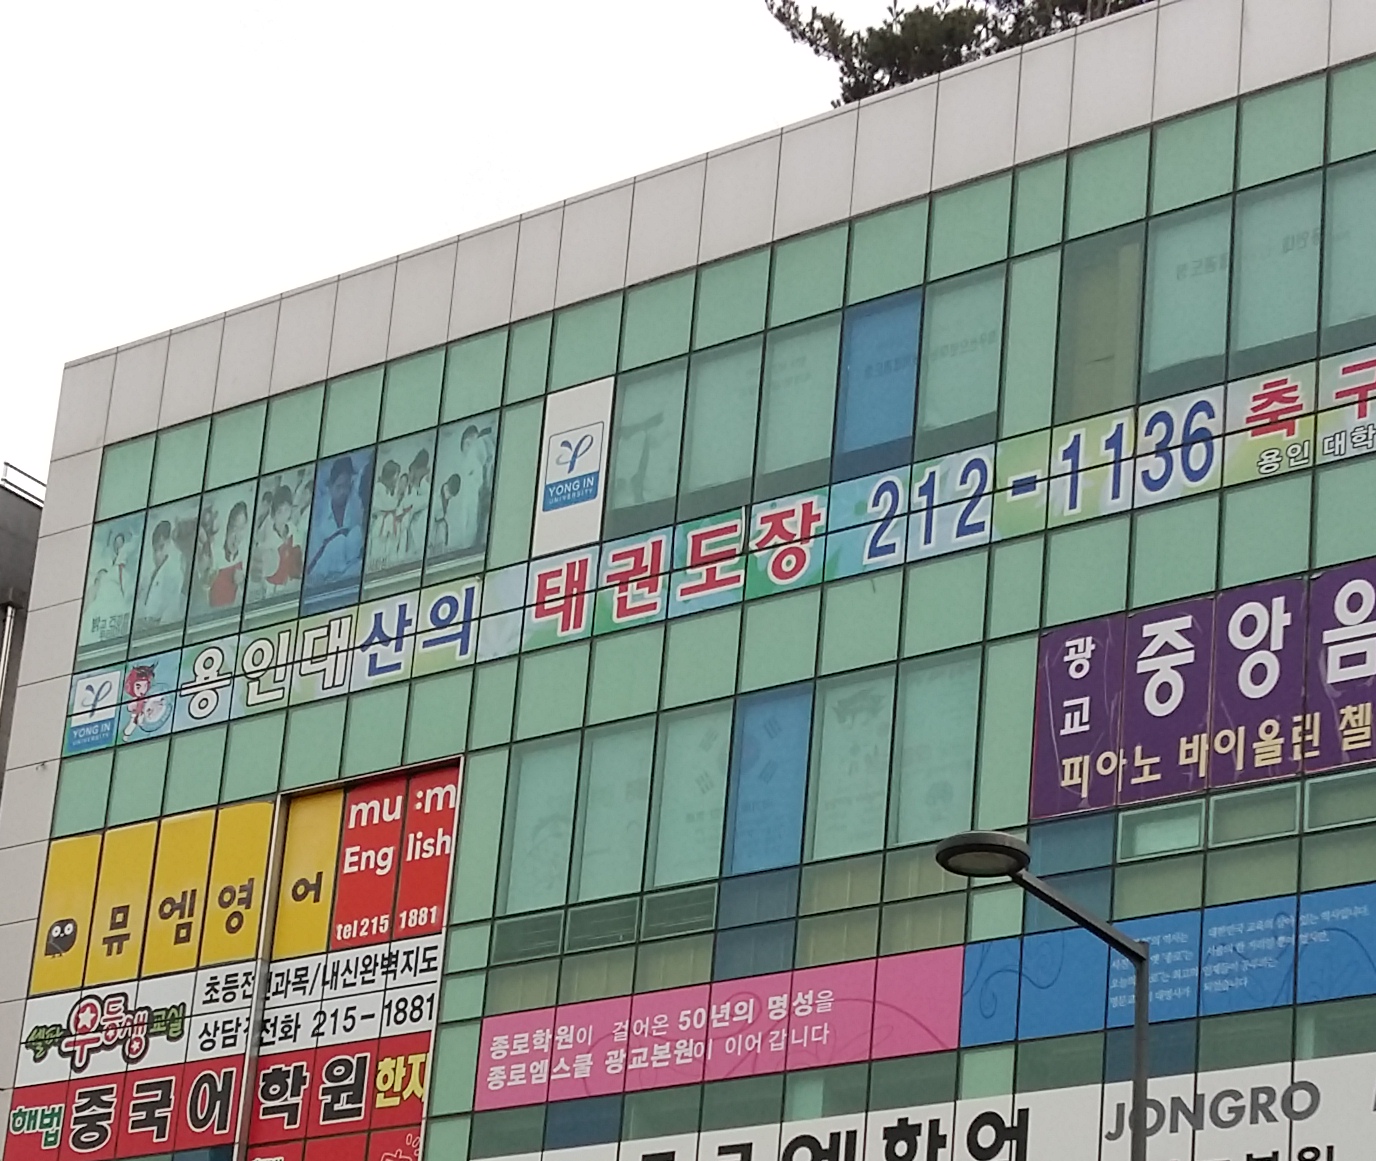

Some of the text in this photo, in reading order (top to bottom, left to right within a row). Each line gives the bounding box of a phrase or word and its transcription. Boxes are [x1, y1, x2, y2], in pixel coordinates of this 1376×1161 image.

[548, 475, 594, 497] YONG IN
[867, 400, 1216, 560] 212-1136
[533, 501, 822, 633] 태권도장
[1060, 637, 1095, 735] 광교
[73, 722, 112, 739] YONG IN
[1060, 746, 1161, 798] 피아노
[1179, 713, 1320, 777] 바이올린
[102, 872, 324, 956] 뮤엠영어
[399, 906, 438, 929] 1881
[61, 995, 148, 1071] 우등생
[150, 1003, 186, 1040] 교실
[199, 1013, 301, 1052] 상담전화
[491, 989, 834, 1058] 종로학원이 걸어온 50년의 명성을
[486, 1037, 712, 1090] 종로엠스쿨 광교본원이
[11, 1052, 427, 1152] 해법 중국어 학원 한자
[1104, 1080, 1321, 1141] JONGRO
